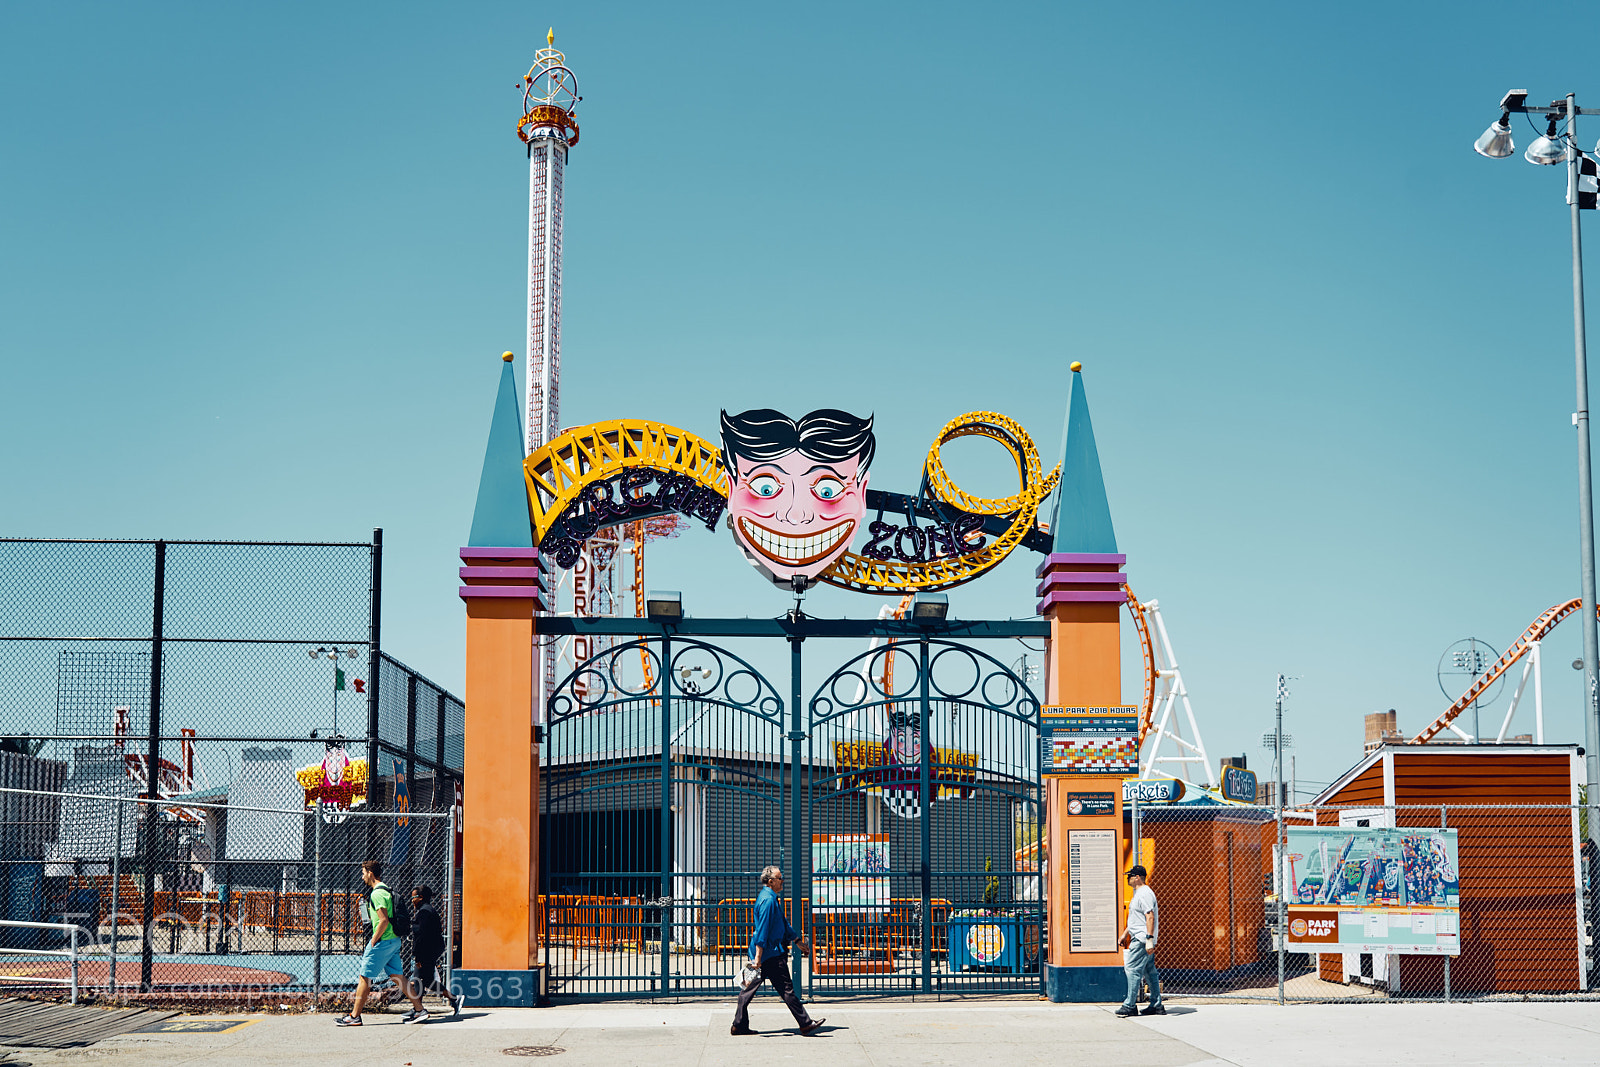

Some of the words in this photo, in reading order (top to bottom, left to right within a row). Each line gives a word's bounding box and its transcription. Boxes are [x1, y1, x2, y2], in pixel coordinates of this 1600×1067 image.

[542, 467, 727, 570] SCREAM
[861, 513, 987, 562] ZONE
[1042, 706, 1064, 714] LUNA
[1065, 706, 1087, 714] PARK
[1089, 706, 1108, 714] 2018
[1110, 706, 1136, 714] HOURS
[1228, 769, 1253, 799] Tickets
[1308, 919, 1336, 928] PARK
[1308, 928, 1331, 936] MAP
